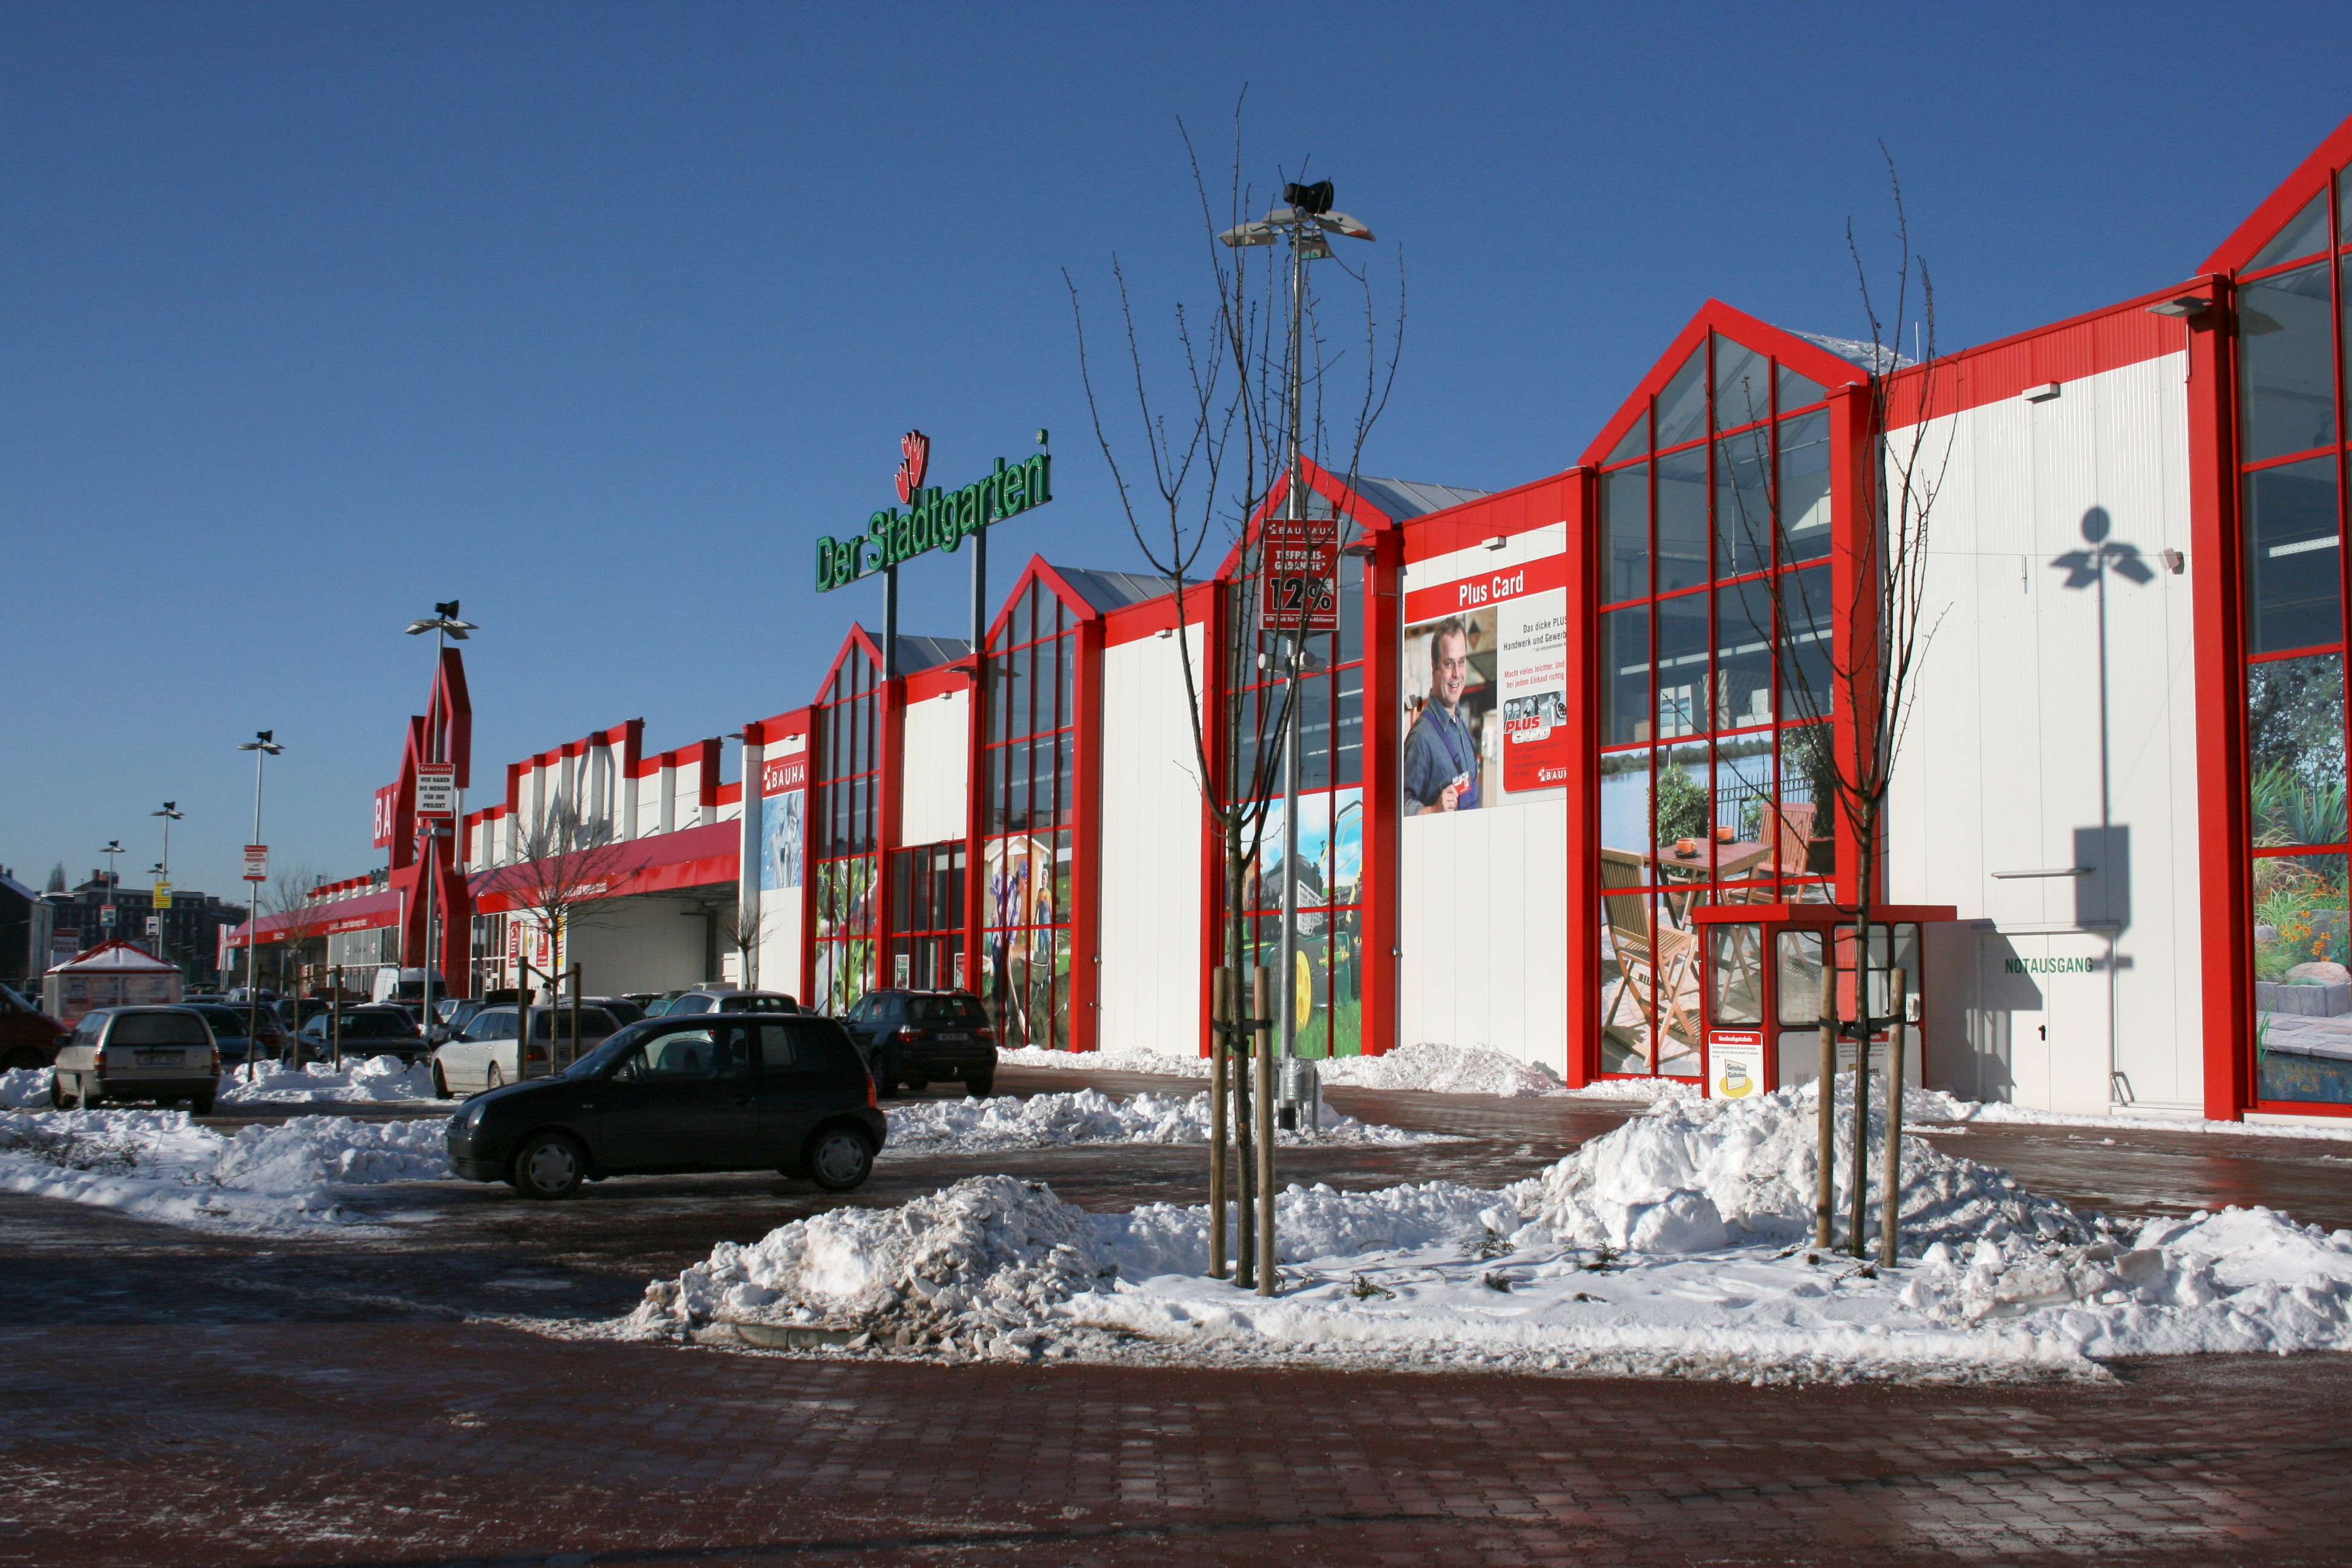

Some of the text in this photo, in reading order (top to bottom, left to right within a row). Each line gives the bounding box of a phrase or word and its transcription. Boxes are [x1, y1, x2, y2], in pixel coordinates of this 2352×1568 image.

[816, 454, 1050, 592] Der Stadtgarten
[1275, 550, 1326, 560] TEFPRIS-
[1274, 561, 1326, 570] GARANIE
[1270, 578, 1332, 611] 12%
[1459, 570, 1524, 607] Plus Card
[1523, 624, 1534, 633] Das
[1535, 620, 1551, 631] dicke
[1503, 638, 1531, 651] Handwerk
[1533, 635, 1544, 645] und
[1504, 660, 1565, 678] Macht vieles leichter. Und
[1515, 679, 1529, 688] jedem
[1530, 675, 1548, 684] Einkauf
[1549, 672, 1565, 681] richtig
[1504, 715, 1541, 734] PLUS
[1512, 725, 1551, 744] CARD
[772, 764, 805, 788] BAUHA
[2005, 957, 2093, 973] NOTAUSGANG
